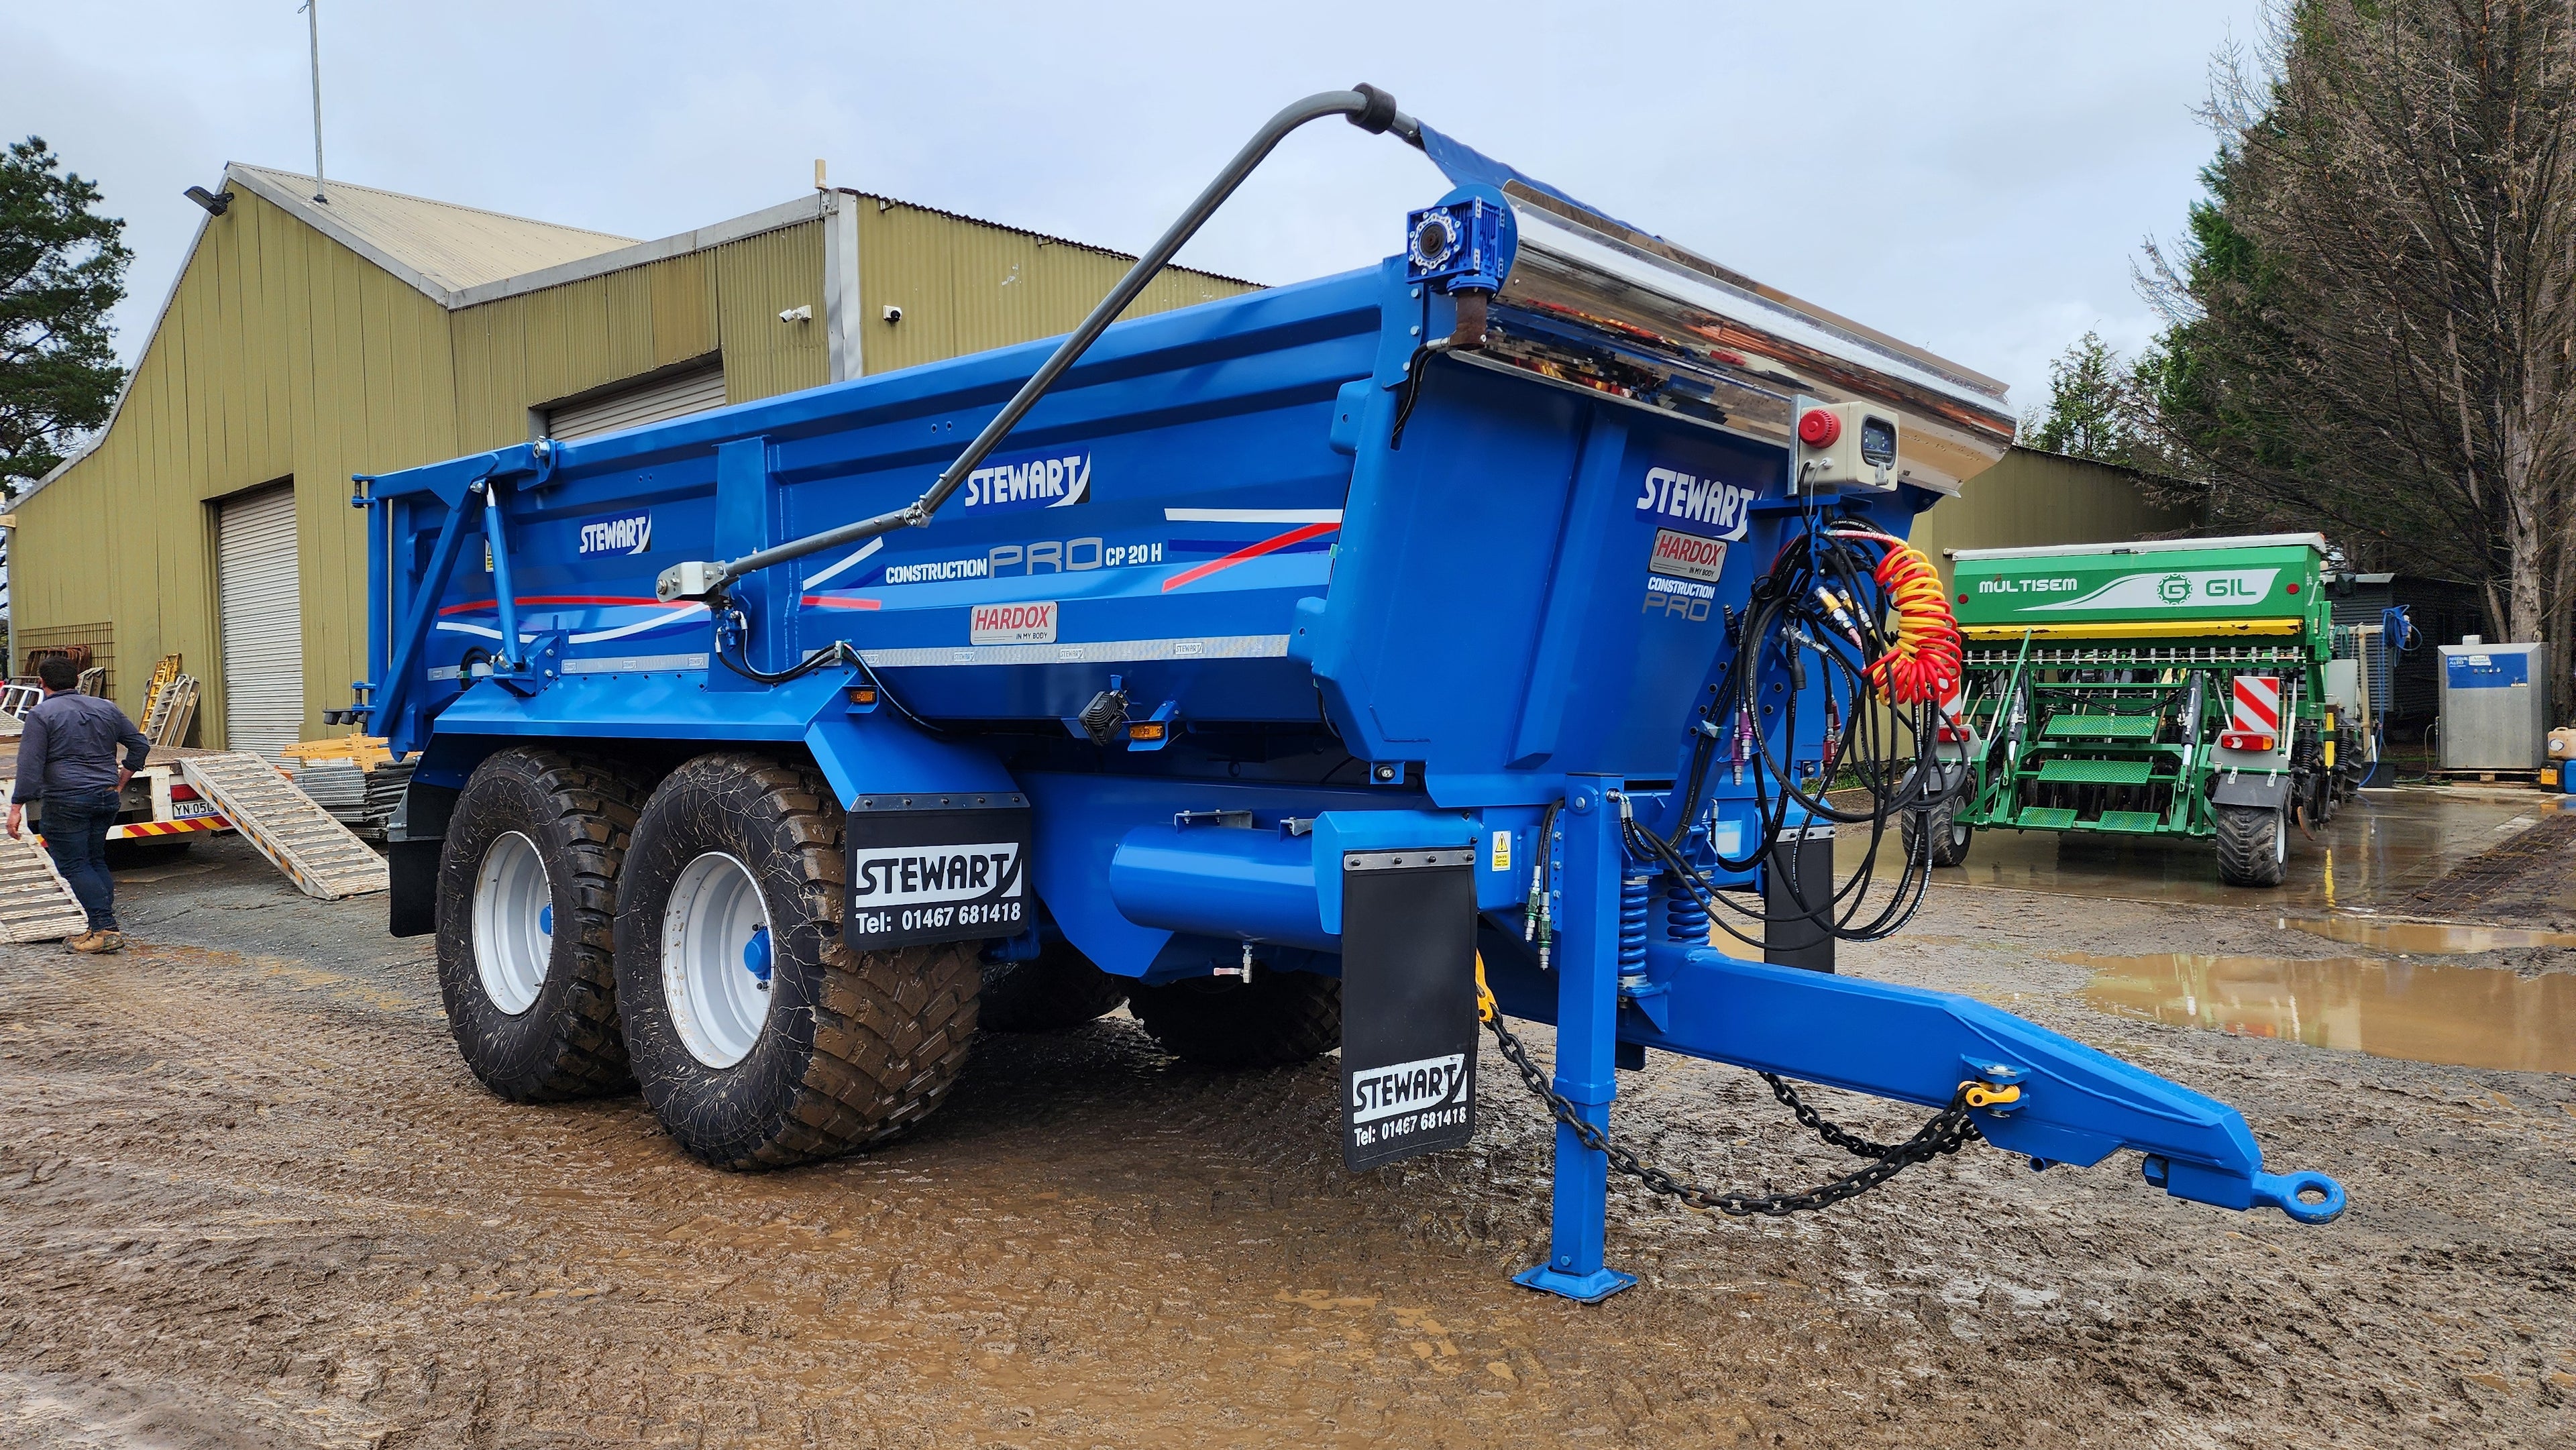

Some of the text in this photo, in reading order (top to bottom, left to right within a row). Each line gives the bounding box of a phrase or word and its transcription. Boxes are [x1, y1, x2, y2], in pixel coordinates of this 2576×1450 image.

[965, 453, 1090, 508] STEWART
[1636, 467, 1755, 541] STEWART
[579, 514, 651, 555] STEWART
[886, 537, 1162, 583] CONSTRUCTION PRO CP 20 H
[1656, 535, 1723, 566] HARDOX
[1648, 576, 1715, 599] CONSTRUCTION
[1702, 569, 1715, 577] BODY
[1979, 578, 2078, 594] MULTISEM
[2206, 579, 2257, 597] GIL
[974, 606, 1051, 630] HARDOX
[1642, 592, 1711, 621] PRO
[1032, 632, 1048, 640] BODY
[1175, 645, 1201, 654] STEWART
[1061, 649, 1083, 658] STEWART
[856, 853, 1020, 900] STEWART
[855, 902, 1021, 934] Tel: 01467 681418
[1354, 1062, 1464, 1113] STEWART
[1354, 1107, 1467, 1147] Tel: 01467 681418
